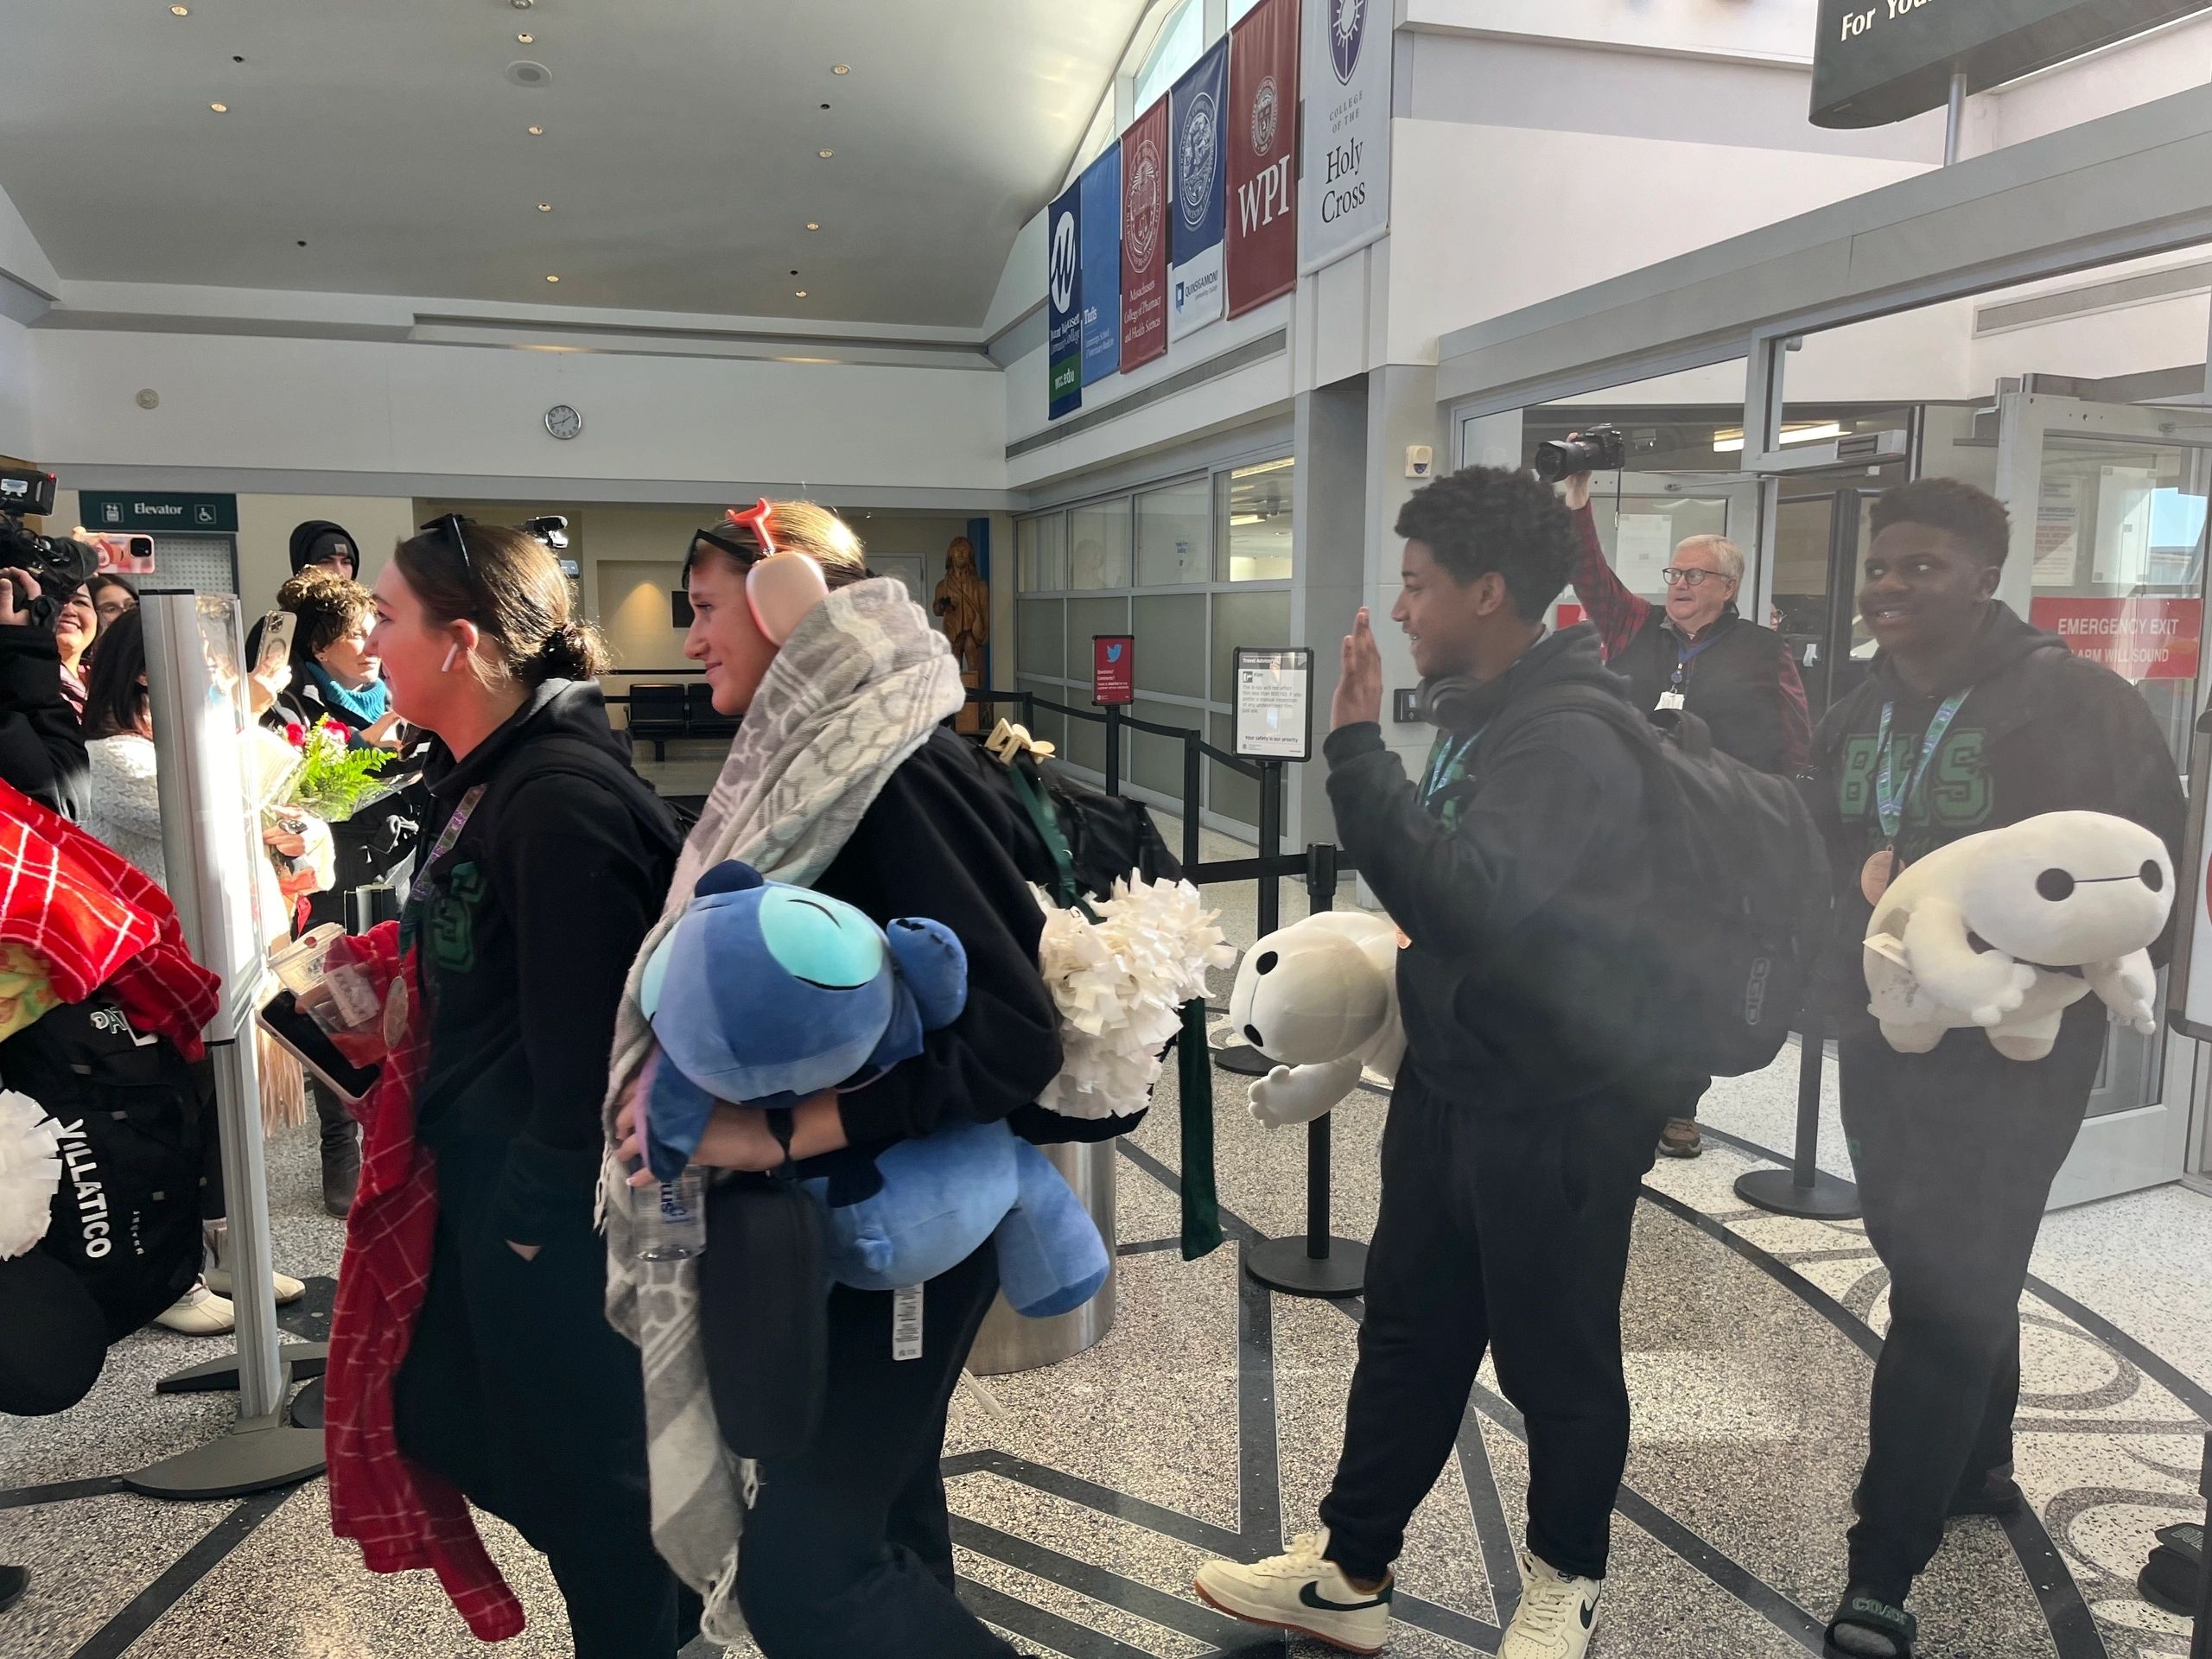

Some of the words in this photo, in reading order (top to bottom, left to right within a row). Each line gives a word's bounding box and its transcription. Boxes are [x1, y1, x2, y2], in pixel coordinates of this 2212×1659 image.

[1840, 8, 1876, 41] For
[1329, 90, 1363, 122] COLLEGE
[1332, 120, 1342, 134] OF
[1344, 108, 1360, 126] THE
[1325, 137, 1363, 184] Holy
[1238, 154, 1290, 238] WPI
[1321, 181, 1365, 224] Cross
[134, 502, 182, 515] Elevator
[2057, 618, 2149, 635] EMERGENCY
[2150, 619, 2179, 635] EXIT
[2071, 648, 2101, 663] ARM
[2104, 648, 2130, 663] WILL
[2133, 648, 2170, 663] SOUND
[57, 1118, 111, 1258] VILLATICO
